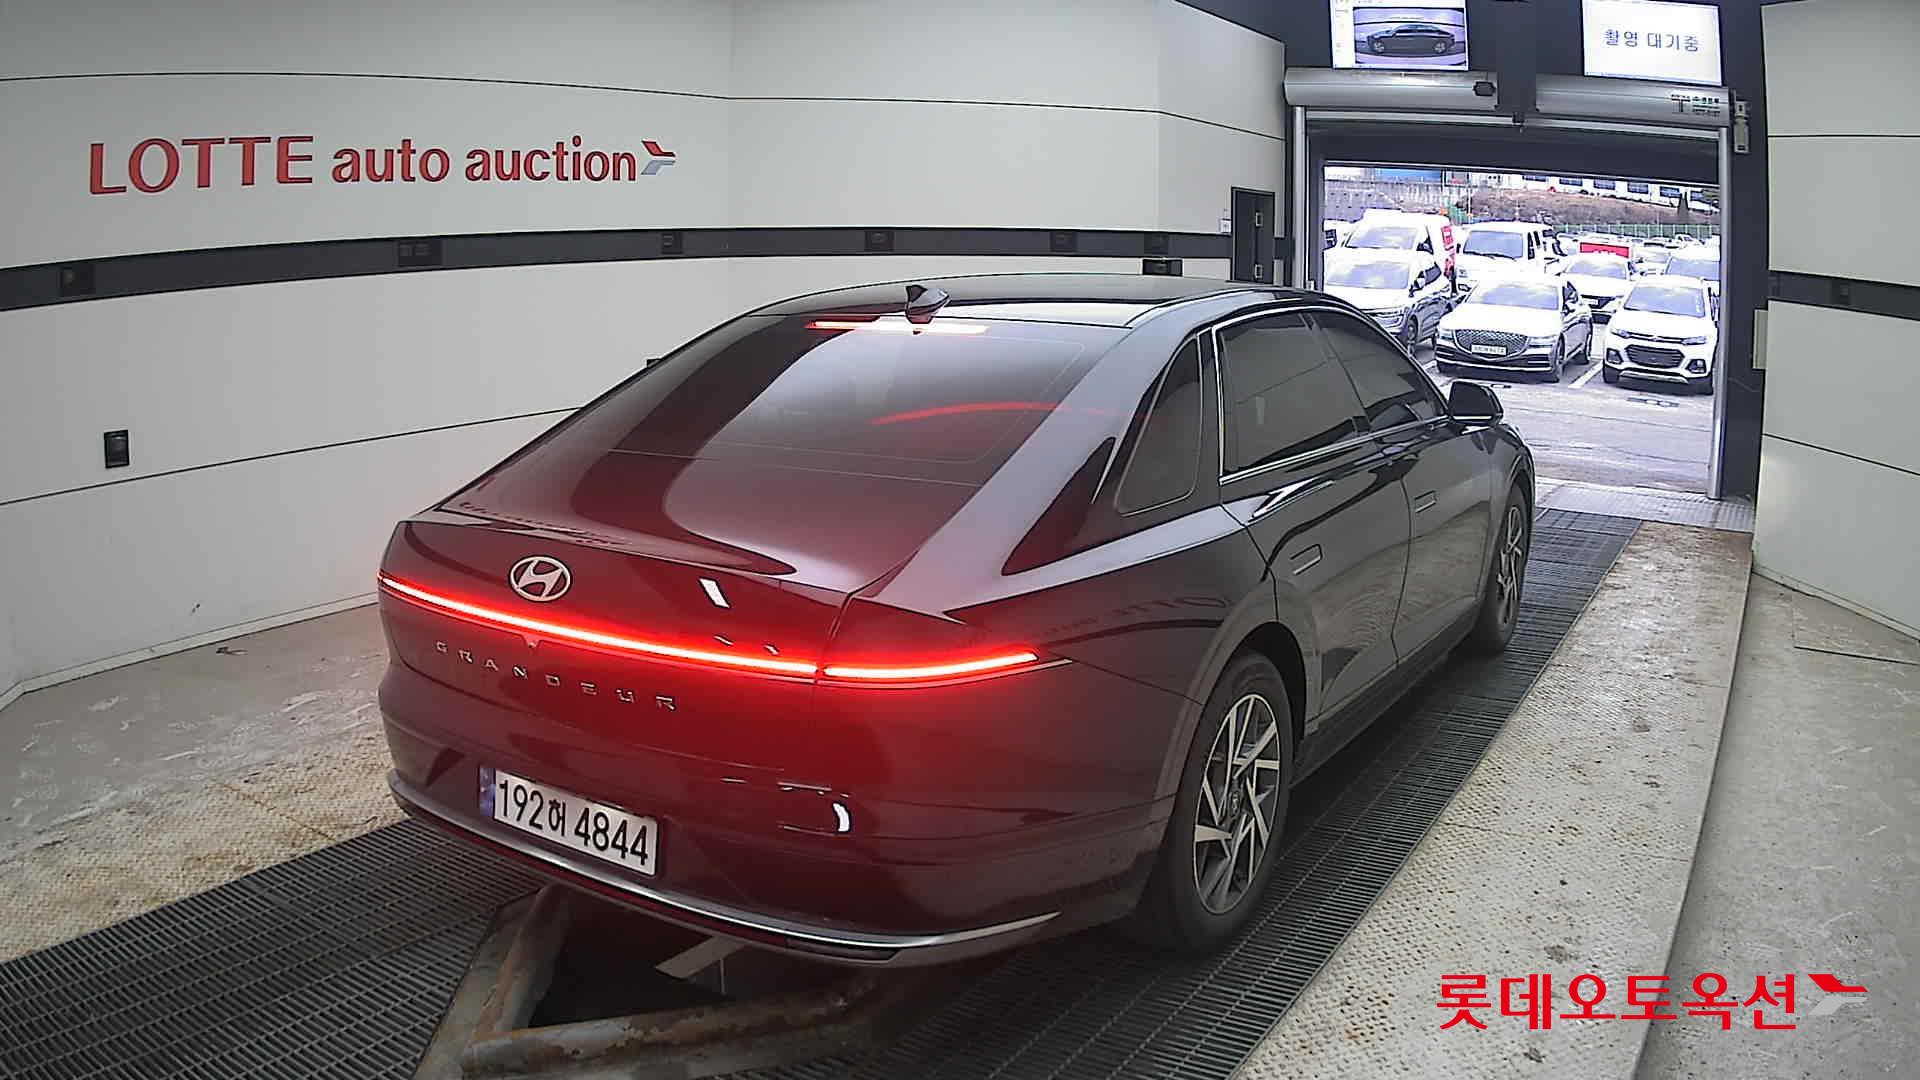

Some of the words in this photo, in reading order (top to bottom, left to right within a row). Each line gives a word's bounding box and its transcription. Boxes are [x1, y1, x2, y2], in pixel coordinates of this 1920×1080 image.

[1646, 32, 1698, 52] 대기중
[90, 136, 313, 195] LOTTE
[331, 139, 450, 183] auto
[465, 136, 638, 182] auction
[434, 638, 677, 713] GRANDEUR
[499, 779, 567, 837] 192허
[573, 806, 649, 867] 4844
